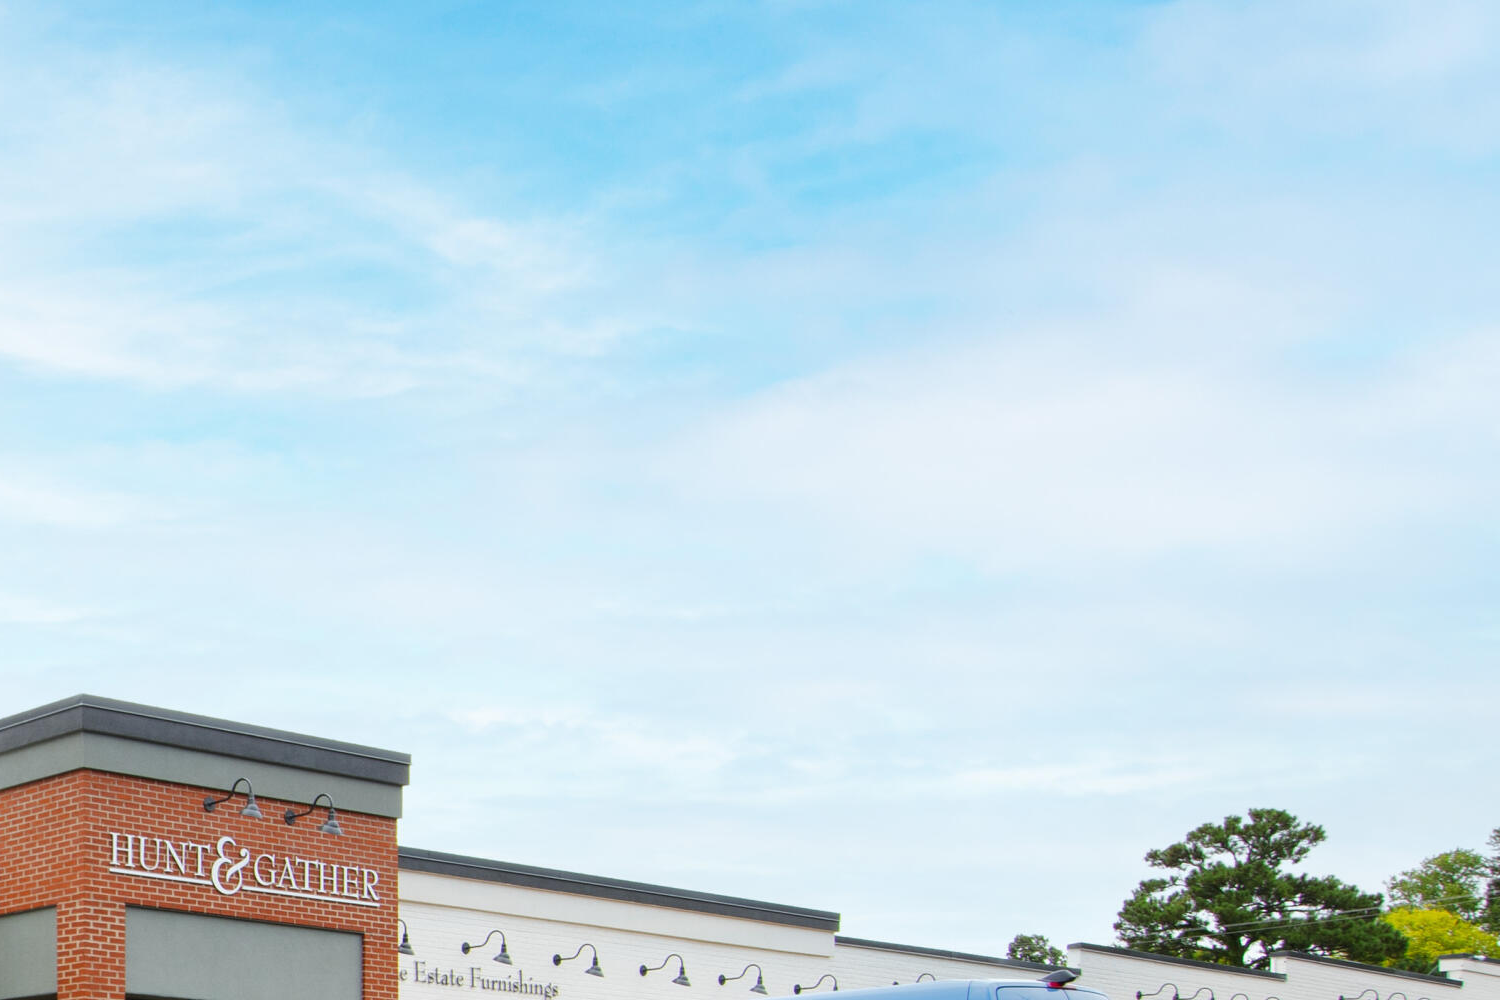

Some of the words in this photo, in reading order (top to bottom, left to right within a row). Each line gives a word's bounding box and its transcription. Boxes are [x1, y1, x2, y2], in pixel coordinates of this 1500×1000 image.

[109, 832, 210, 878] HUNT
[253, 853, 381, 901] GATHER
[414, 960, 465, 988] Estate
